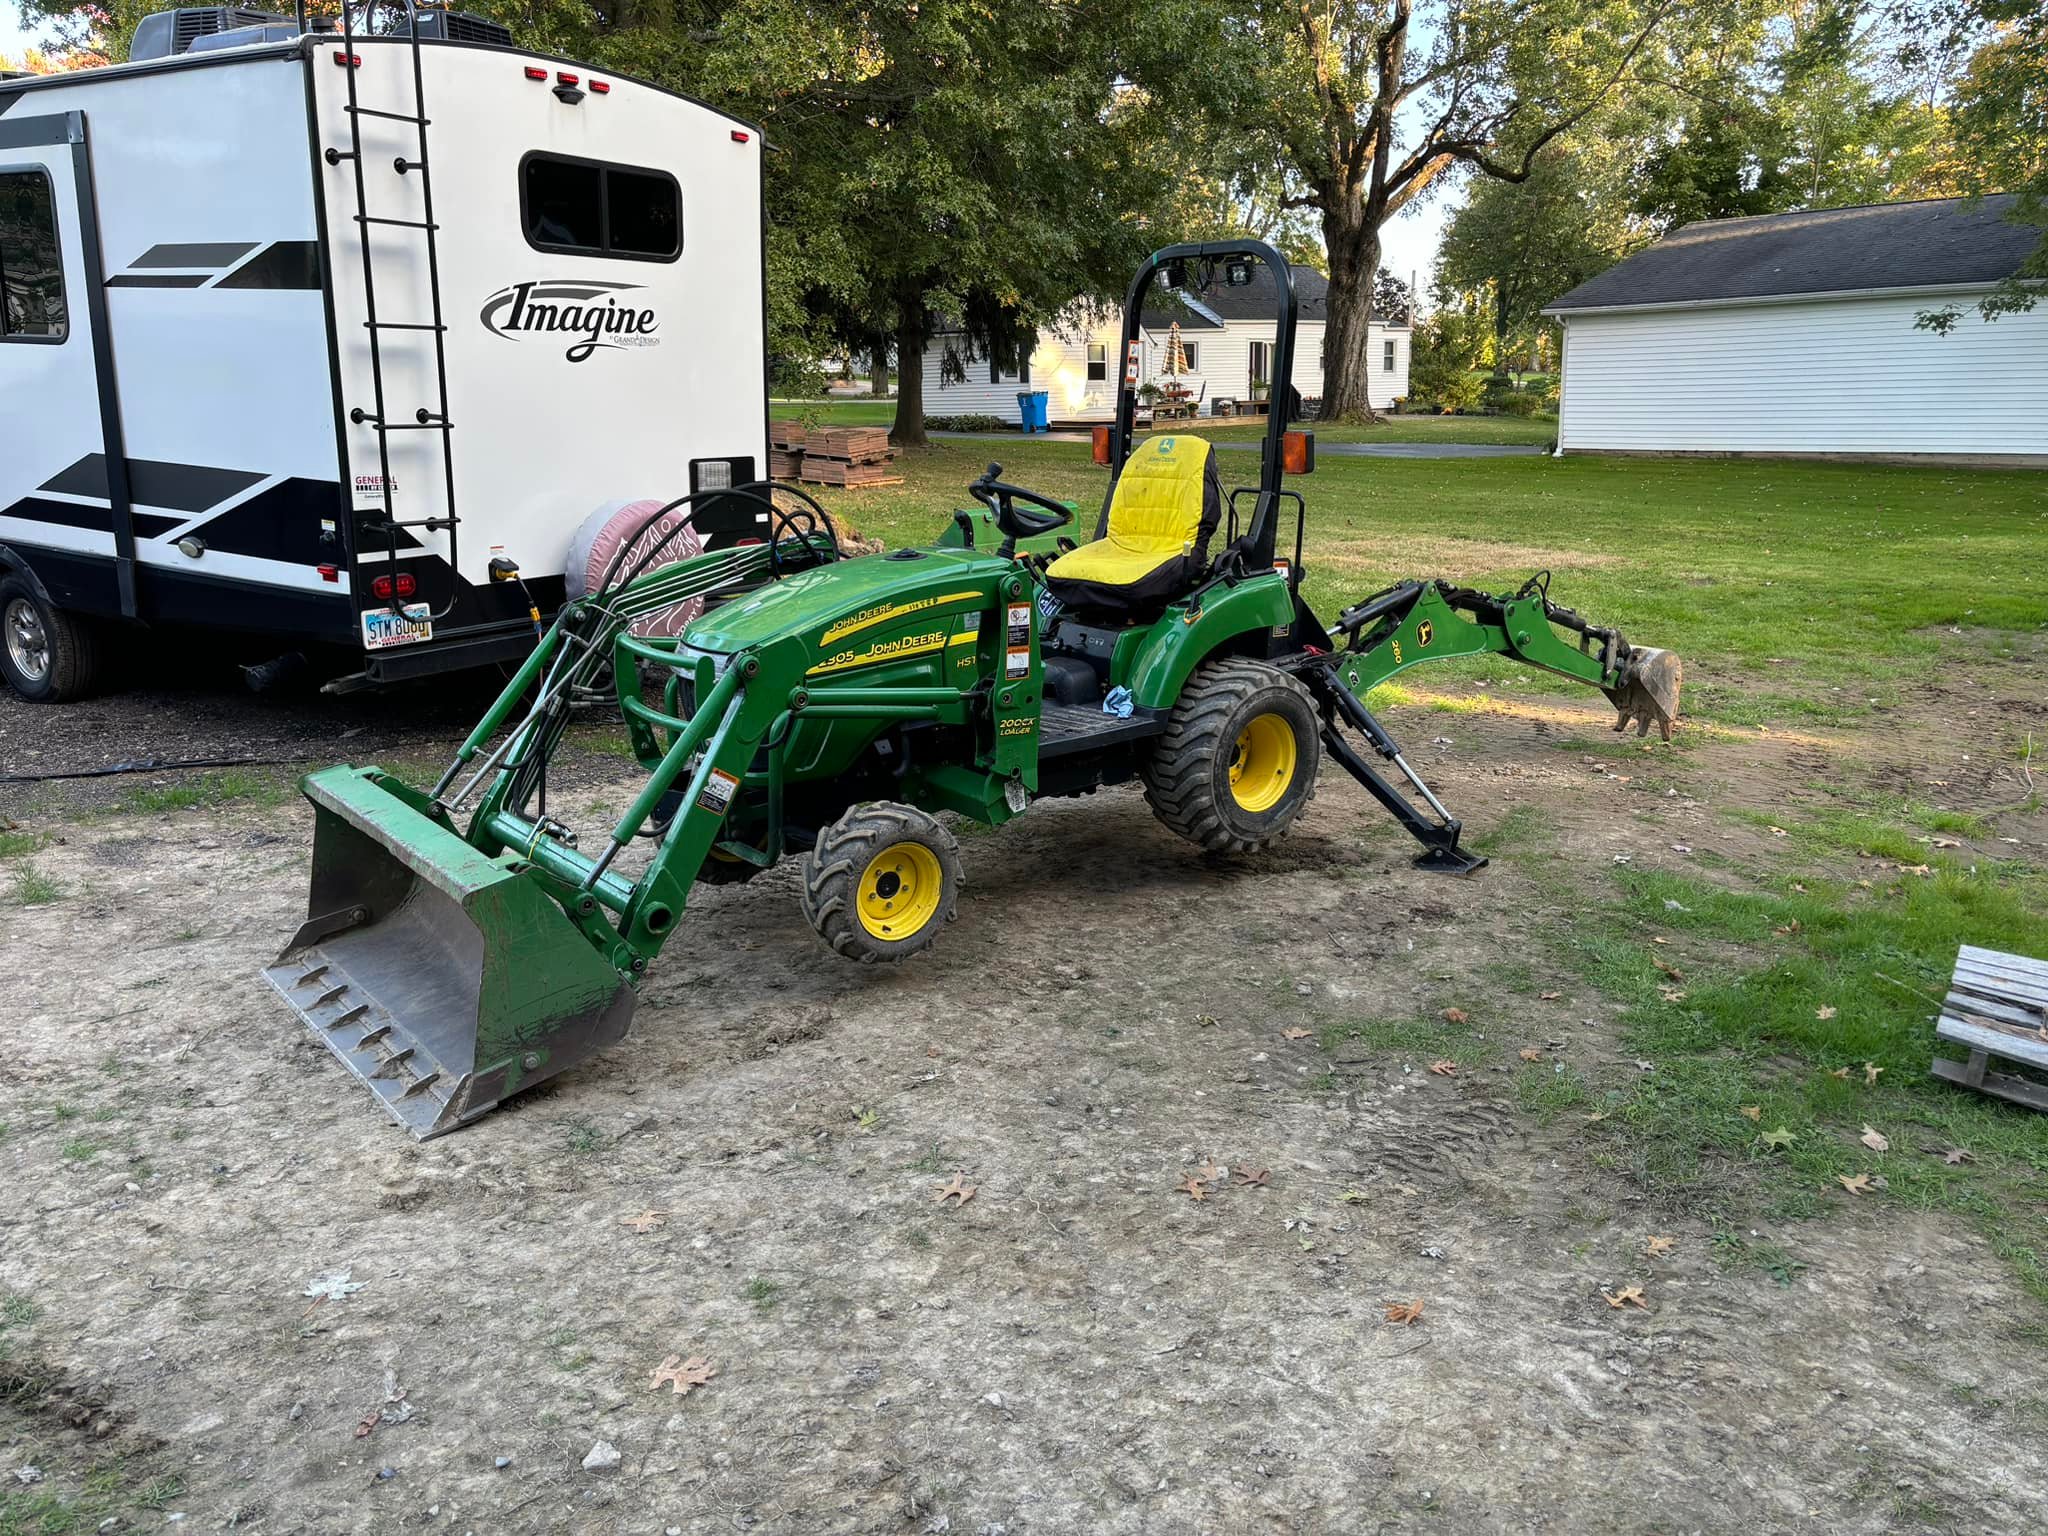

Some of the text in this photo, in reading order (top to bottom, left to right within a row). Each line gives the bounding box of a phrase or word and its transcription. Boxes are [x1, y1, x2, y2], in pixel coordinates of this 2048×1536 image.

[501, 281, 660, 362] Imagine
[355, 475, 397, 485] GENERL
[830, 613, 861, 633] JOHN
[858, 602, 894, 621] DEERE
[368, 619, 392, 640] STM
[865, 640, 901, 657] JOHN
[901, 631, 945, 650] DEERE
[999, 727, 1031, 736] LOADER
